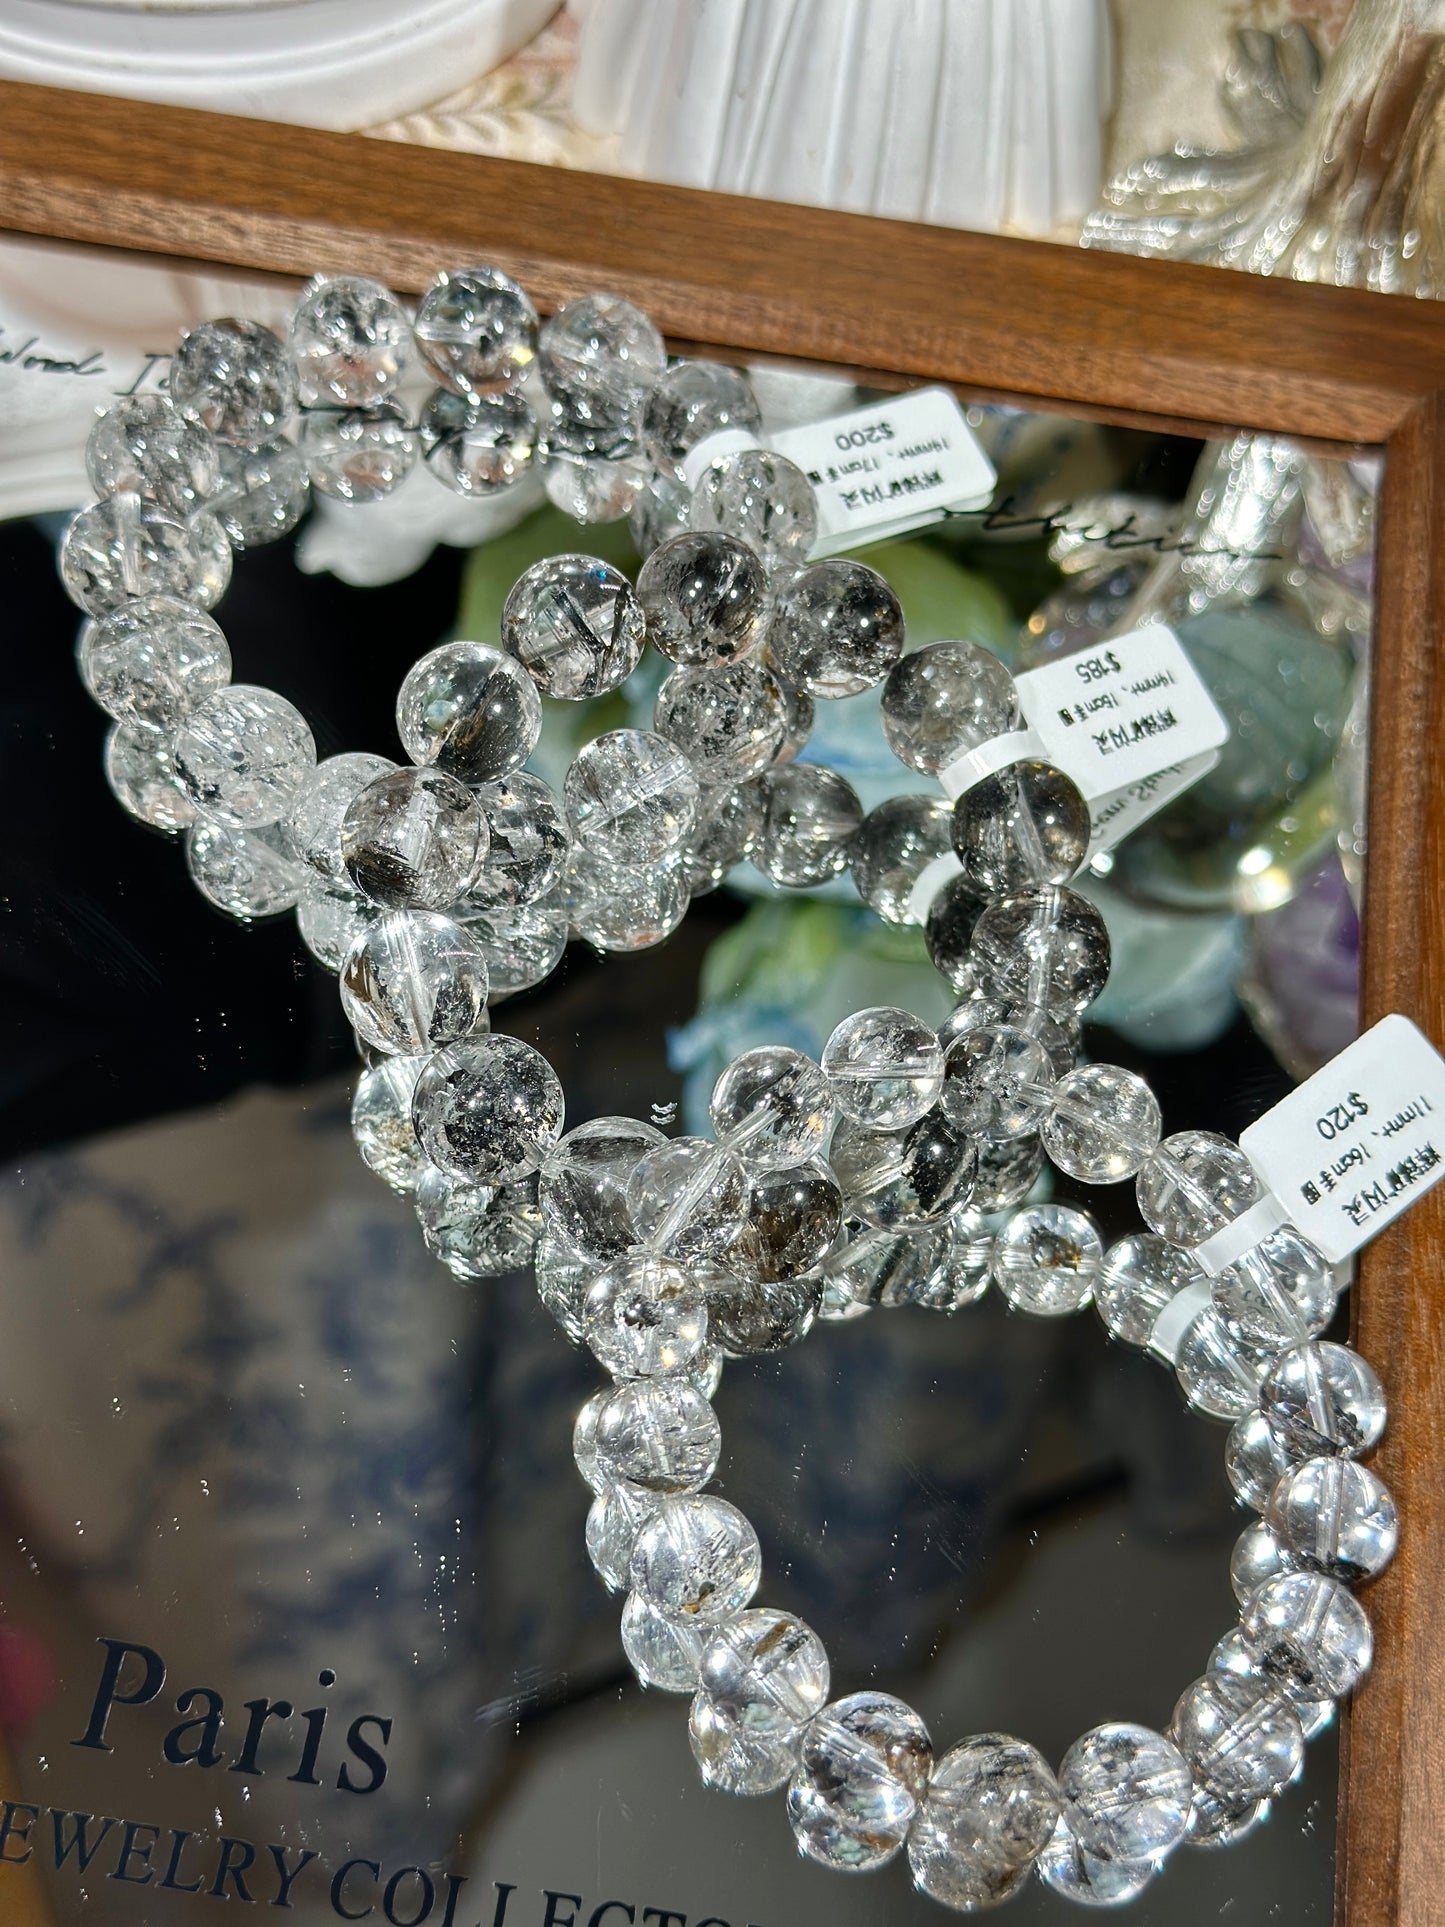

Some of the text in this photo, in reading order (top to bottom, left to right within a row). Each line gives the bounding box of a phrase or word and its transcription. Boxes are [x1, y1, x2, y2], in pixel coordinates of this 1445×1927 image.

[835, 422, 895, 451] $200
[1075, 650, 1122, 684] $185
[1316, 1091, 1369, 1140] $120
[70, 1636, 394, 1795] Paris
